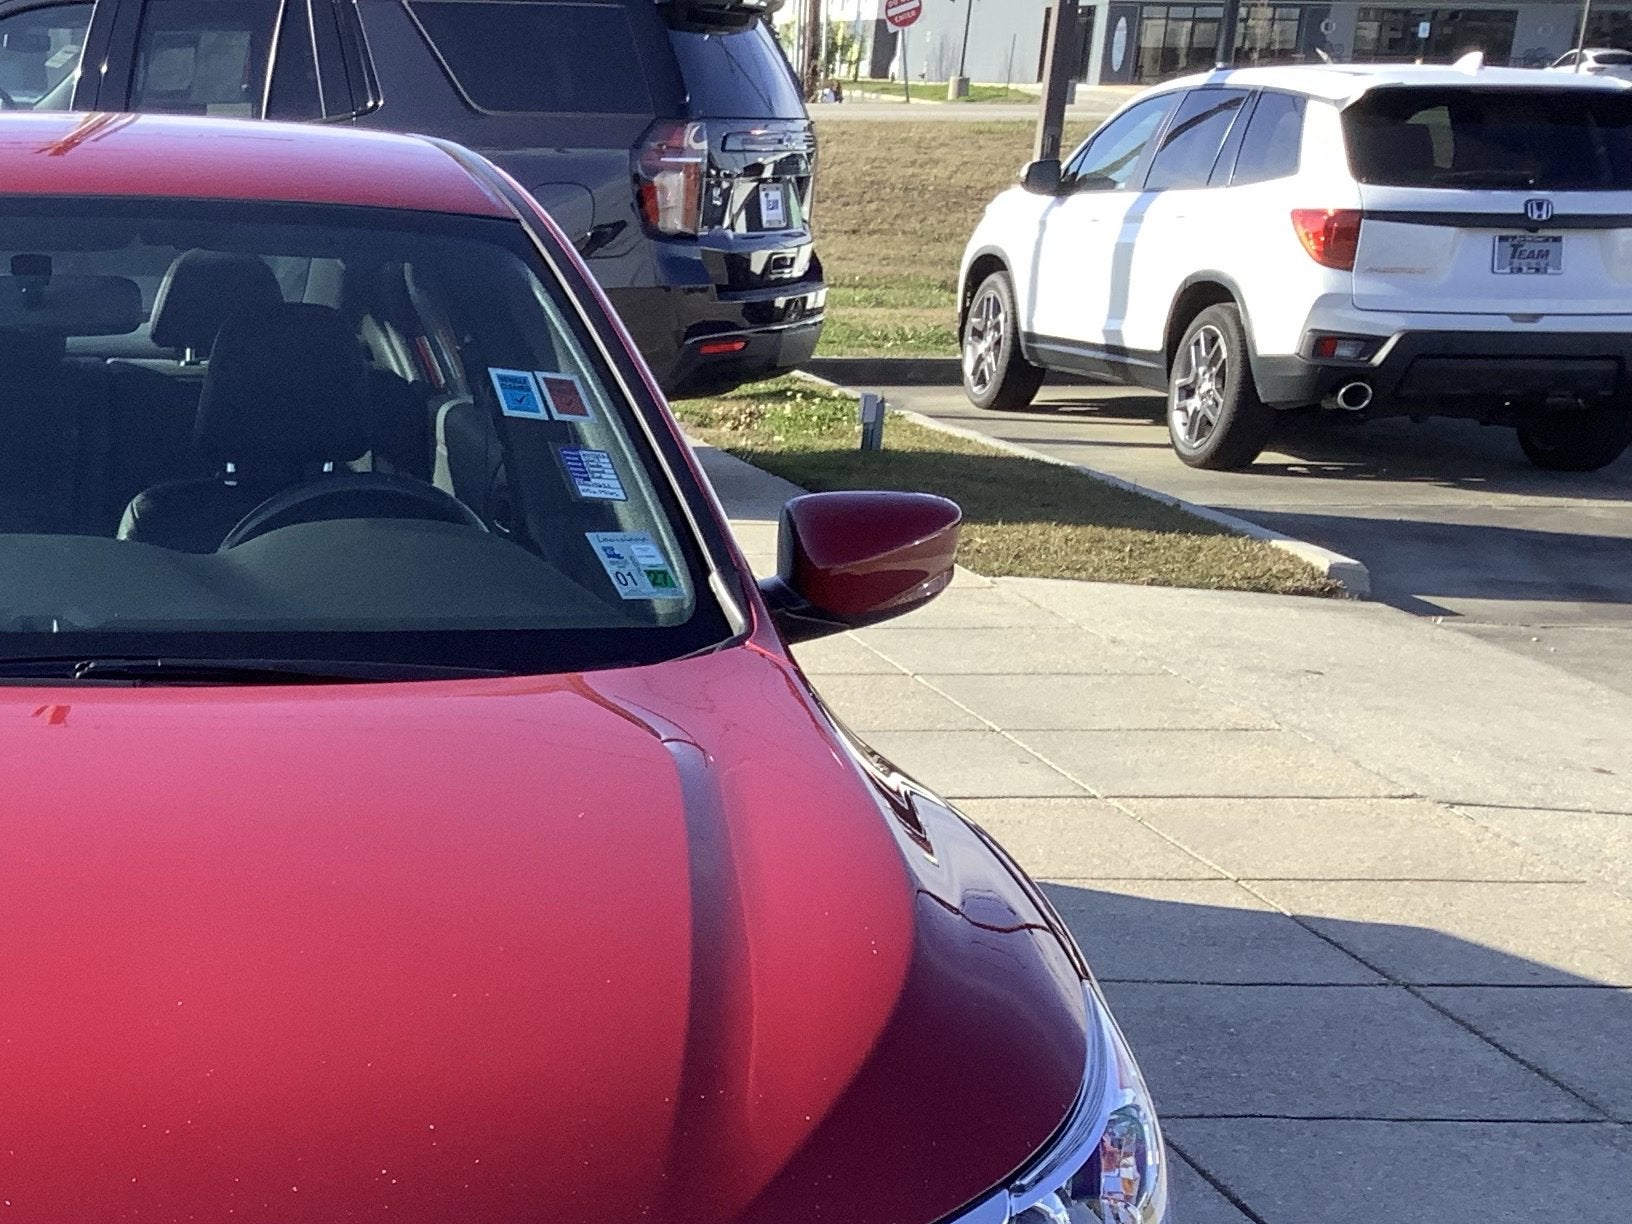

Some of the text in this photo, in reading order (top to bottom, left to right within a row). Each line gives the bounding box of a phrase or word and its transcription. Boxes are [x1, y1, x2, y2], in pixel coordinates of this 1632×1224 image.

[895, 10, 916, 22] ENTER
[1510, 243, 1550, 260] TEAM
[615, 571, 638, 587] 01
